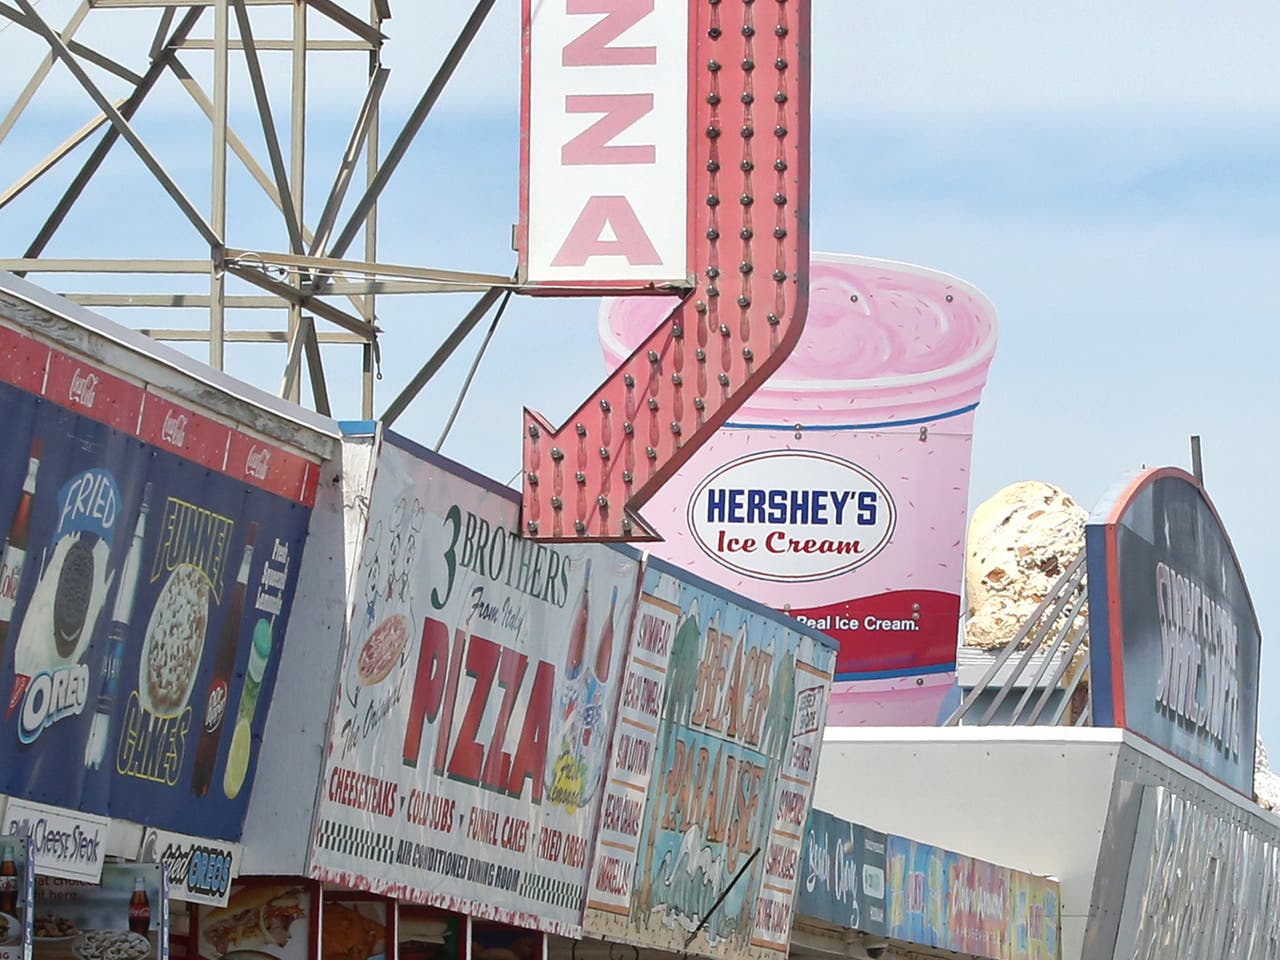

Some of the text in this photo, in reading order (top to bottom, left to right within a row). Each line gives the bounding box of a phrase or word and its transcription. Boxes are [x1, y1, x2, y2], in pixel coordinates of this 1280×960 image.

[58, 472, 116, 534] FRIED
[707, 488, 877, 527] HERSHEY'S
[431, 504, 572, 612] 3 BROTHERS
[717, 532, 866, 556] Ice Cream
[470, 584, 500, 624] From
[835, 616, 859, 630] Ice
[864, 616, 919, 631] Cream.
[21, 664, 89, 741] OREO
[402, 615, 556, 806] PIZZA
[692, 627, 774, 747] BEACH
[329, 766, 589, 870] CHEESESTEAKS COLD SUBS FUNNEL CAKES FRIED OREOS
[661, 737, 767, 877] PARADISE
[34, 818, 72, 861] Cheese
[72, 824, 100, 862] Steak
[395, 836, 520, 893] AIR CONDITIONED DINING ROOM
[161, 843, 233, 897] fried OREOS
